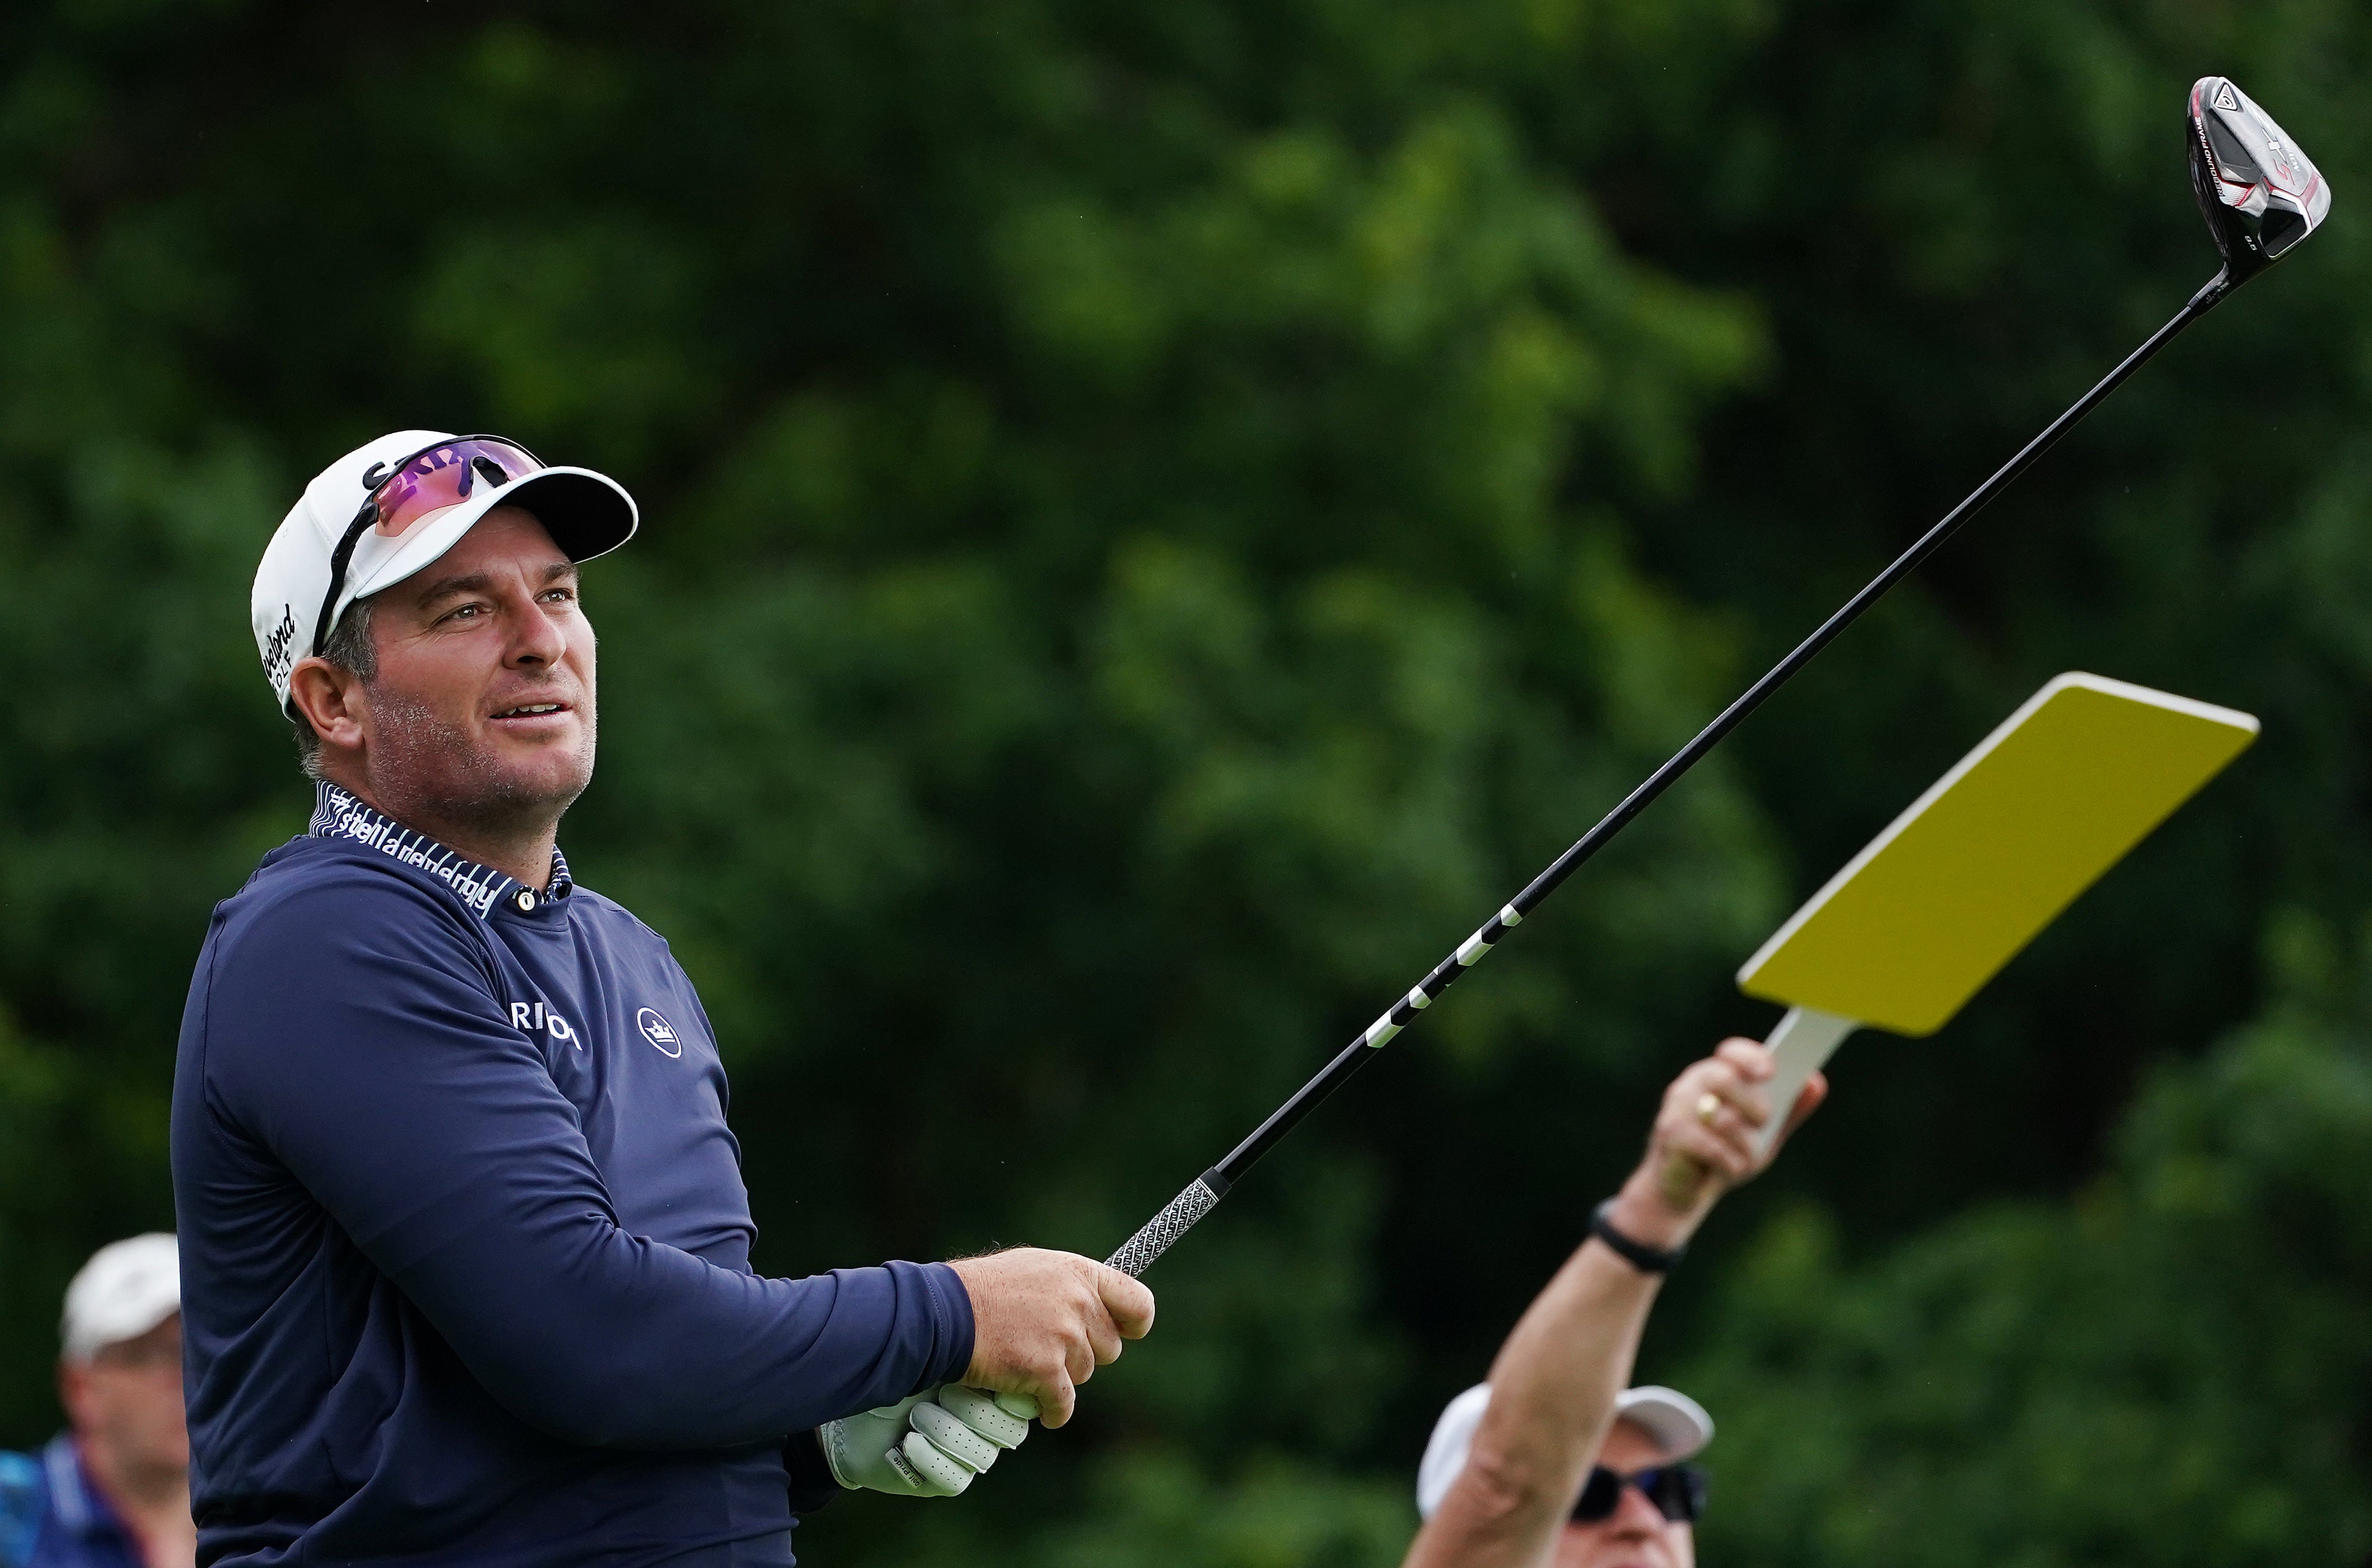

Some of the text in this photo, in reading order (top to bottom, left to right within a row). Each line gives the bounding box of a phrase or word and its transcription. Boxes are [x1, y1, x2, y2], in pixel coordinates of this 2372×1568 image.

[2194, 116, 2225, 196] REBOUND FRAME
[893, 1457, 920, 1486] Golf Pride
